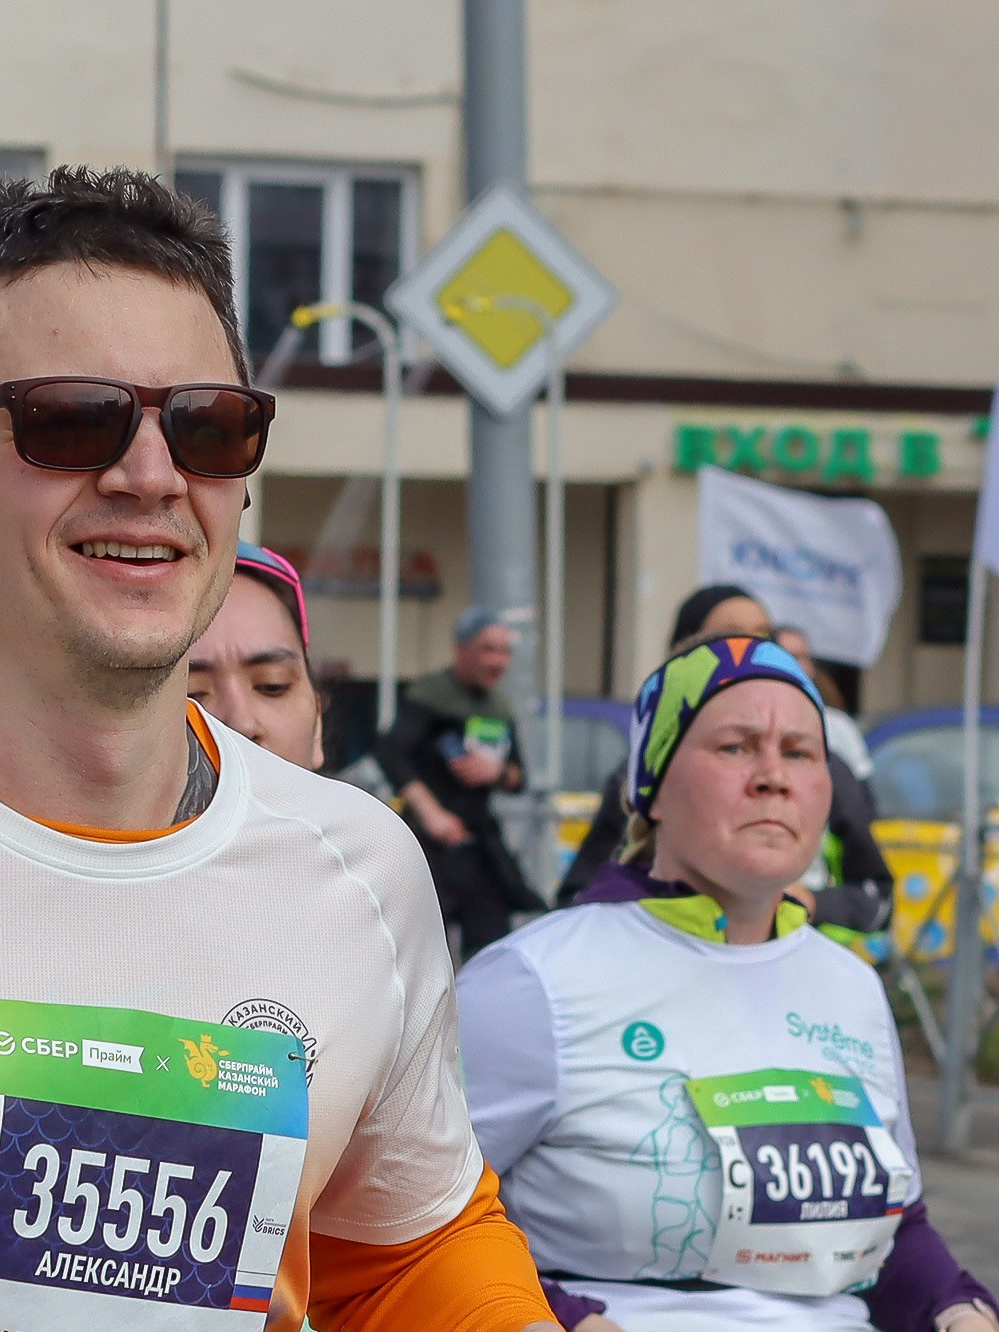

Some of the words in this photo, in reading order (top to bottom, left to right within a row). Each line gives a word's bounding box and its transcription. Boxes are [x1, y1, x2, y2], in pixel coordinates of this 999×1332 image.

[676, 424, 874, 484] ВХОД
[901, 431, 941, 478] В
[228, 1003, 302, 1034] КАЗАНСКИЙ
[21, 1037, 79, 1059] СБЕР
[89, 1047, 132, 1064] Прайм
[218, 1059, 274, 1077] СБЕРПРАЙМ
[218, 1070, 279, 1089] КАЗАНСКИЙ
[217, 1081, 266, 1097] МАРАФОН
[757, 1142, 884, 1201] 36192
[12, 1143, 233, 1263] 35556
[262, 1225, 286, 1236] BRICS
[34, 1250, 182, 1298] АЛЕКСАНДР
